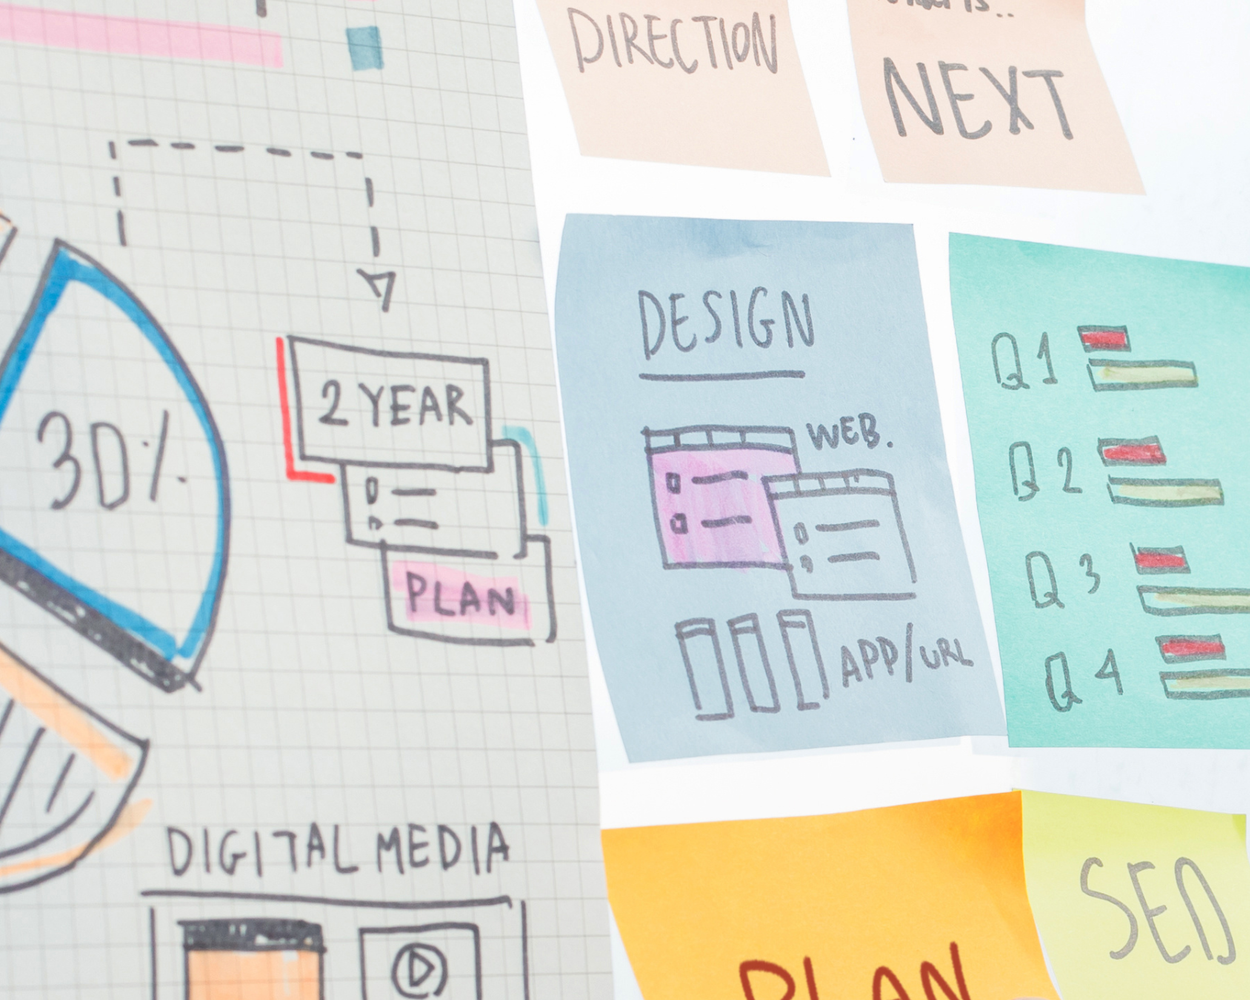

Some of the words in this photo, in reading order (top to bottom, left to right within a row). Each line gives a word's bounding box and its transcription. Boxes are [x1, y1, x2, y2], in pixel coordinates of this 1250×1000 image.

[567, 8, 777, 74] DIRECTION
[883, 57, 1073, 140] NEXT
[638, 286, 814, 361] DESIGN
[318, 379, 349, 426] 2
[358, 383, 474, 427] YEAR
[406, 571, 516, 617] PLAN
[165, 821, 359, 878] DIGITAL
[376, 821, 510, 875] MEDIA
